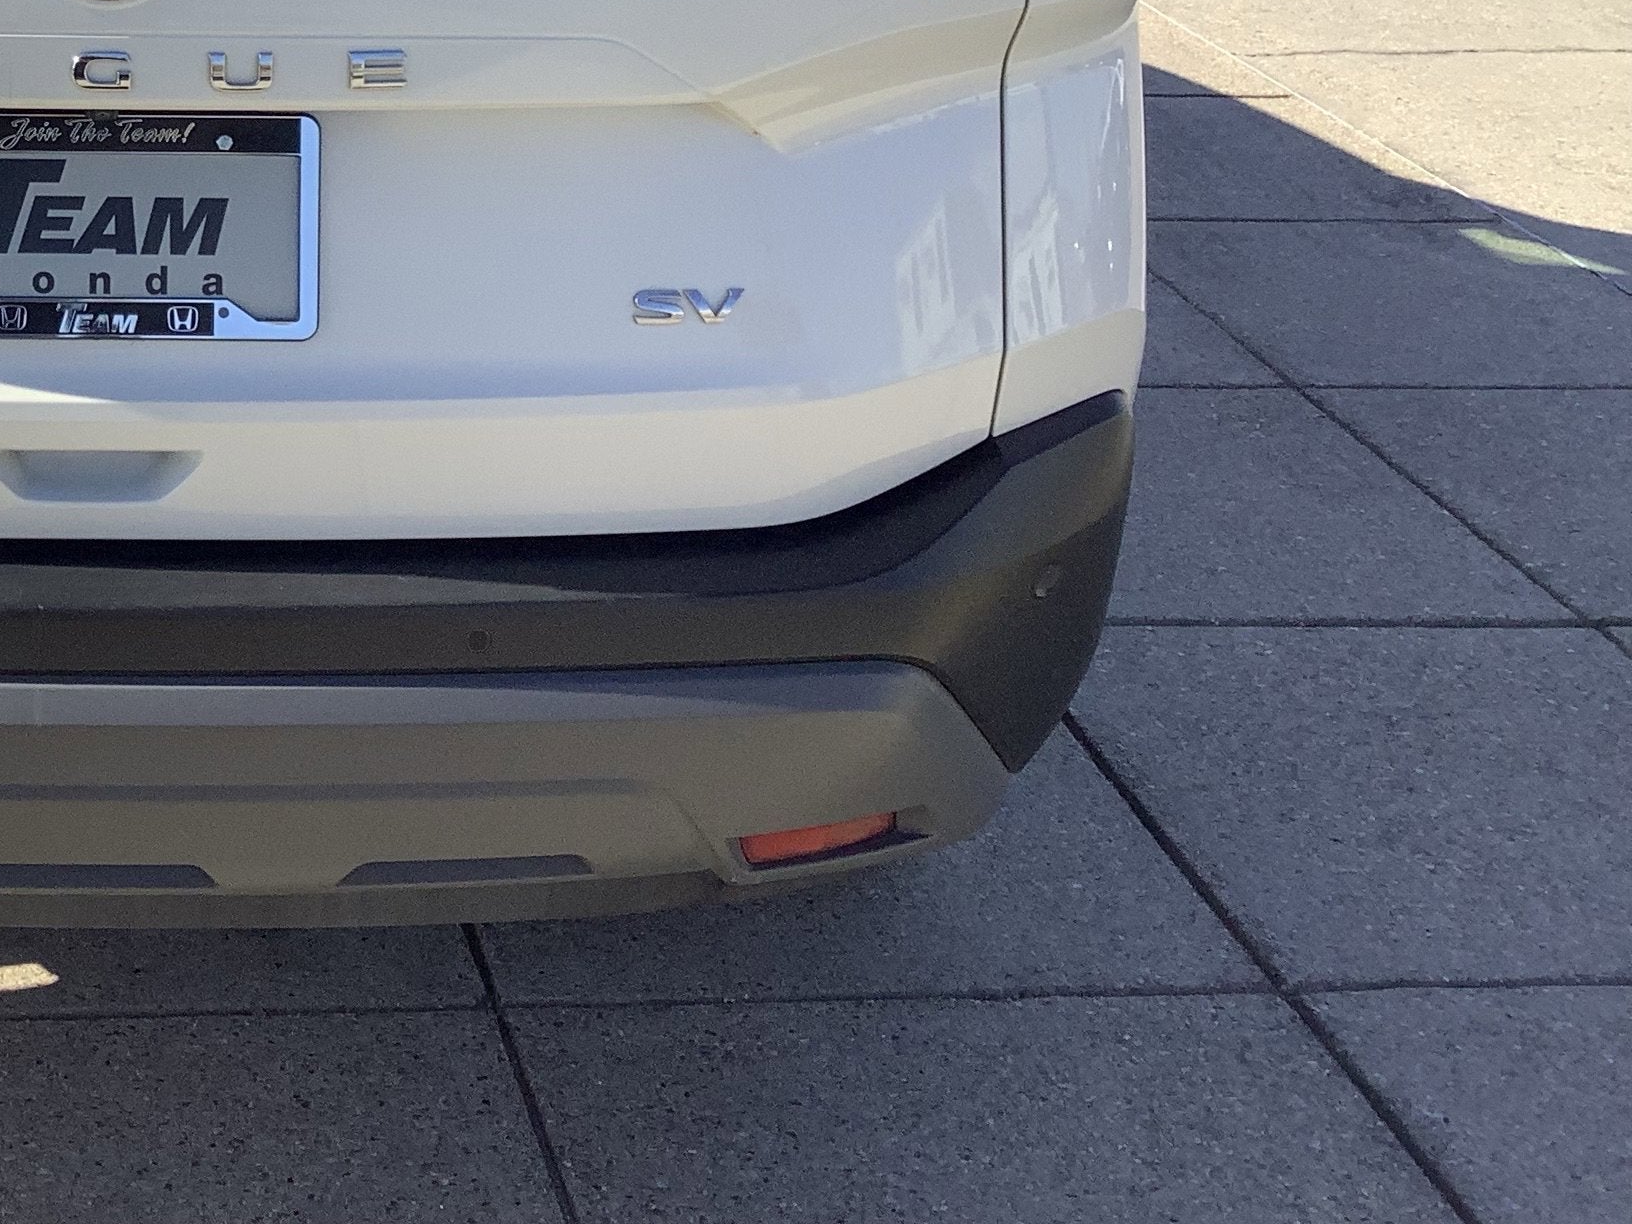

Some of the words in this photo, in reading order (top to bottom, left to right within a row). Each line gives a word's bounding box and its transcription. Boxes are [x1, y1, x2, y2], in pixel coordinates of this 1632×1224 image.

[64, 118, 112, 144] The
[114, 119, 195, 144] Team!
[56, 302, 138, 333] TEAM
[633, 288, 745, 325] SV
